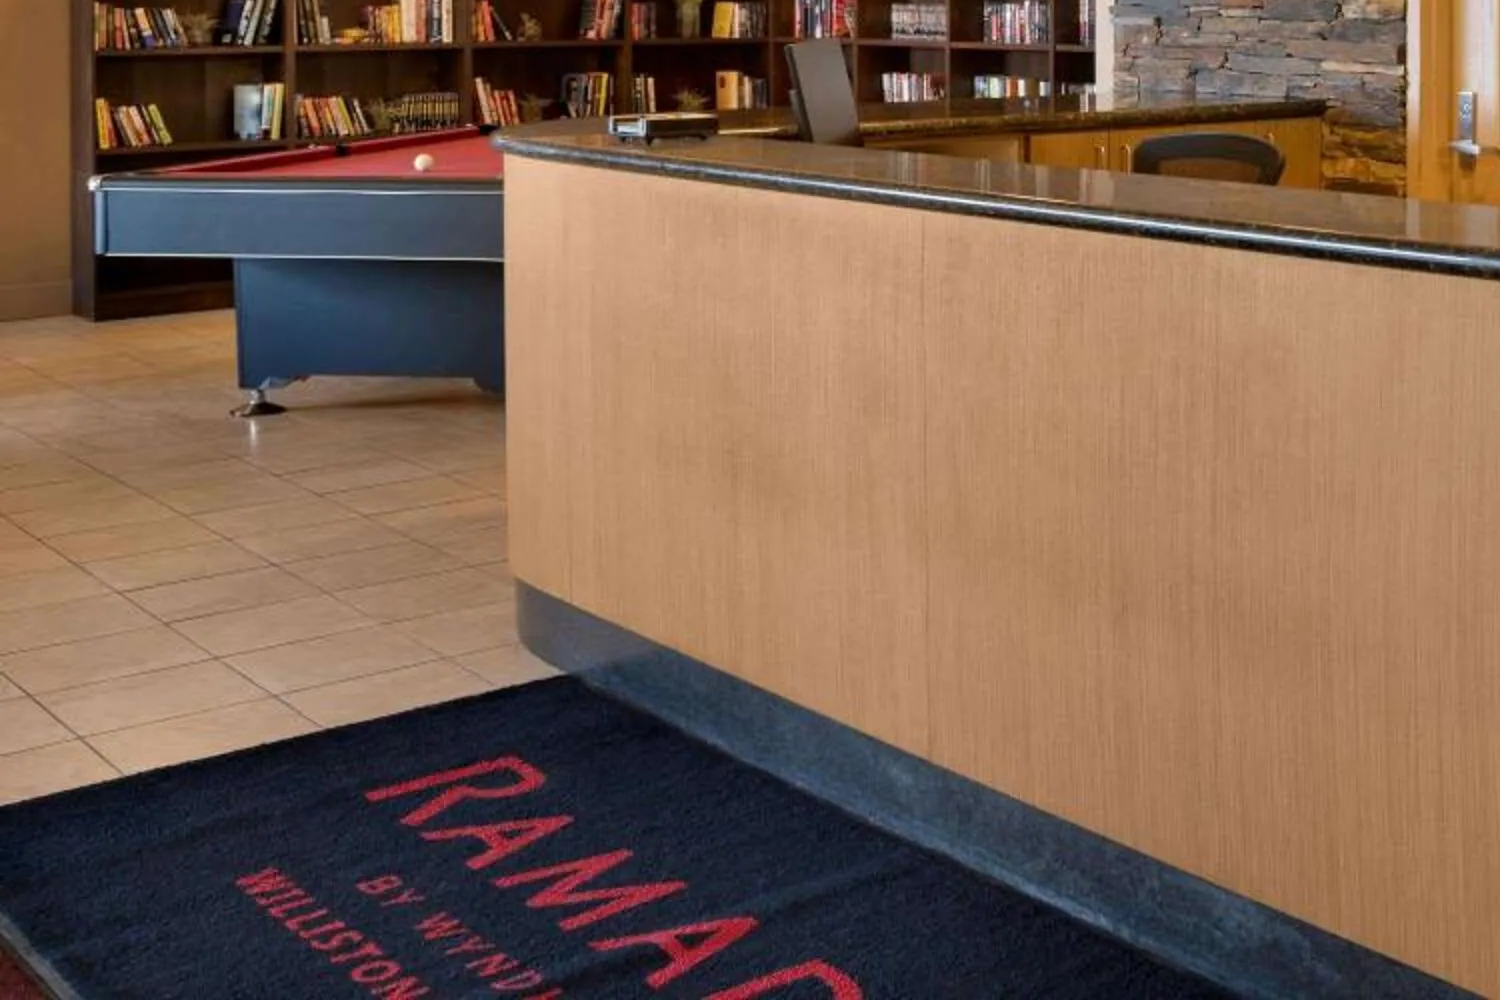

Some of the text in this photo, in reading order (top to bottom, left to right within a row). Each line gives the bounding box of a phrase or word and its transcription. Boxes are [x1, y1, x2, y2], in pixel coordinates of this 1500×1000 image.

[235, 866, 430, 1000] WILLISTON
[355, 875, 563, 1000] BY WYND
